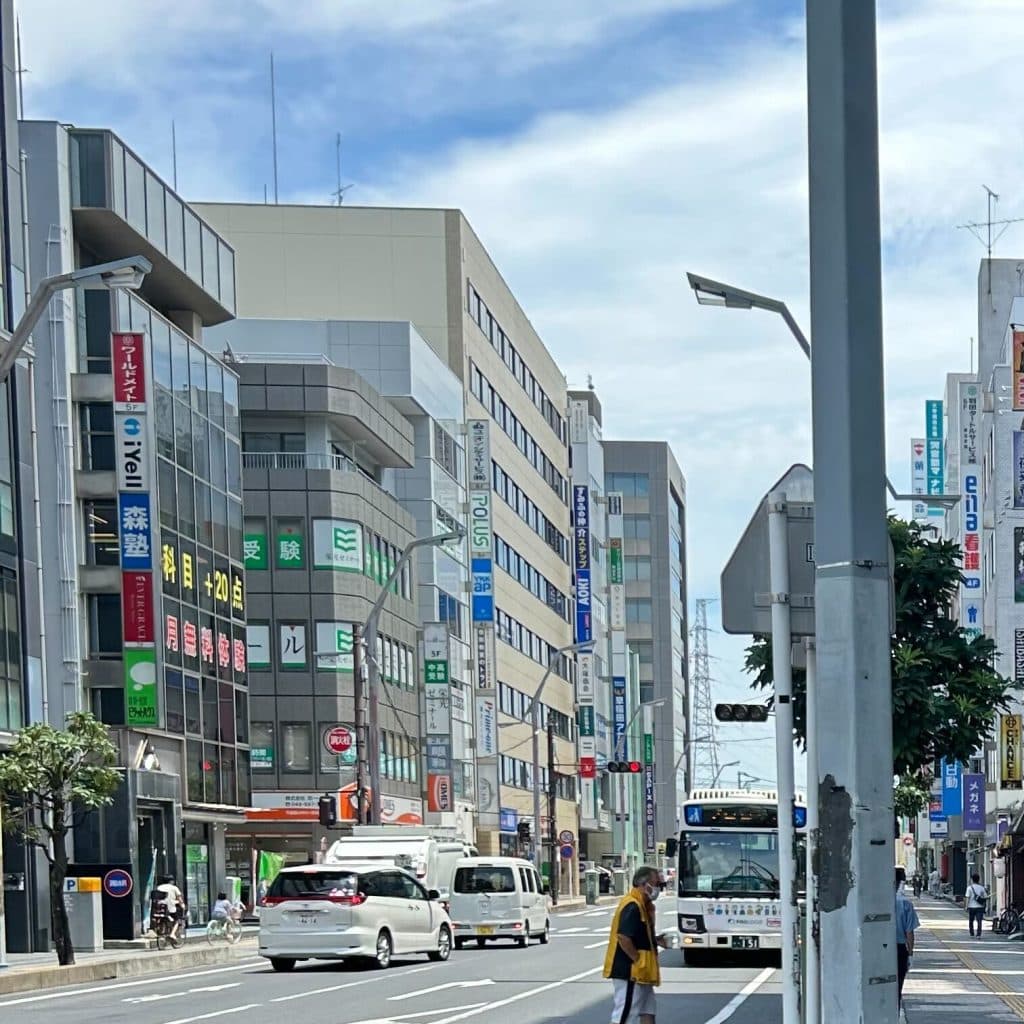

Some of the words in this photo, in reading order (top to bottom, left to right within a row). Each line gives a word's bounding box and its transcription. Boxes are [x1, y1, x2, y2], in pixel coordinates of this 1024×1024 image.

[123, 506, 149, 558] 森塾
[472, 495, 489, 547] POLUS
[965, 534, 980, 570] 看護
[474, 583, 491, 593] ap
[578, 578, 589, 606] AOKI
[1006, 731, 1014, 778] CHANCE
[969, 781, 979, 814] メガネ
[67, 879, 76, 890] P
